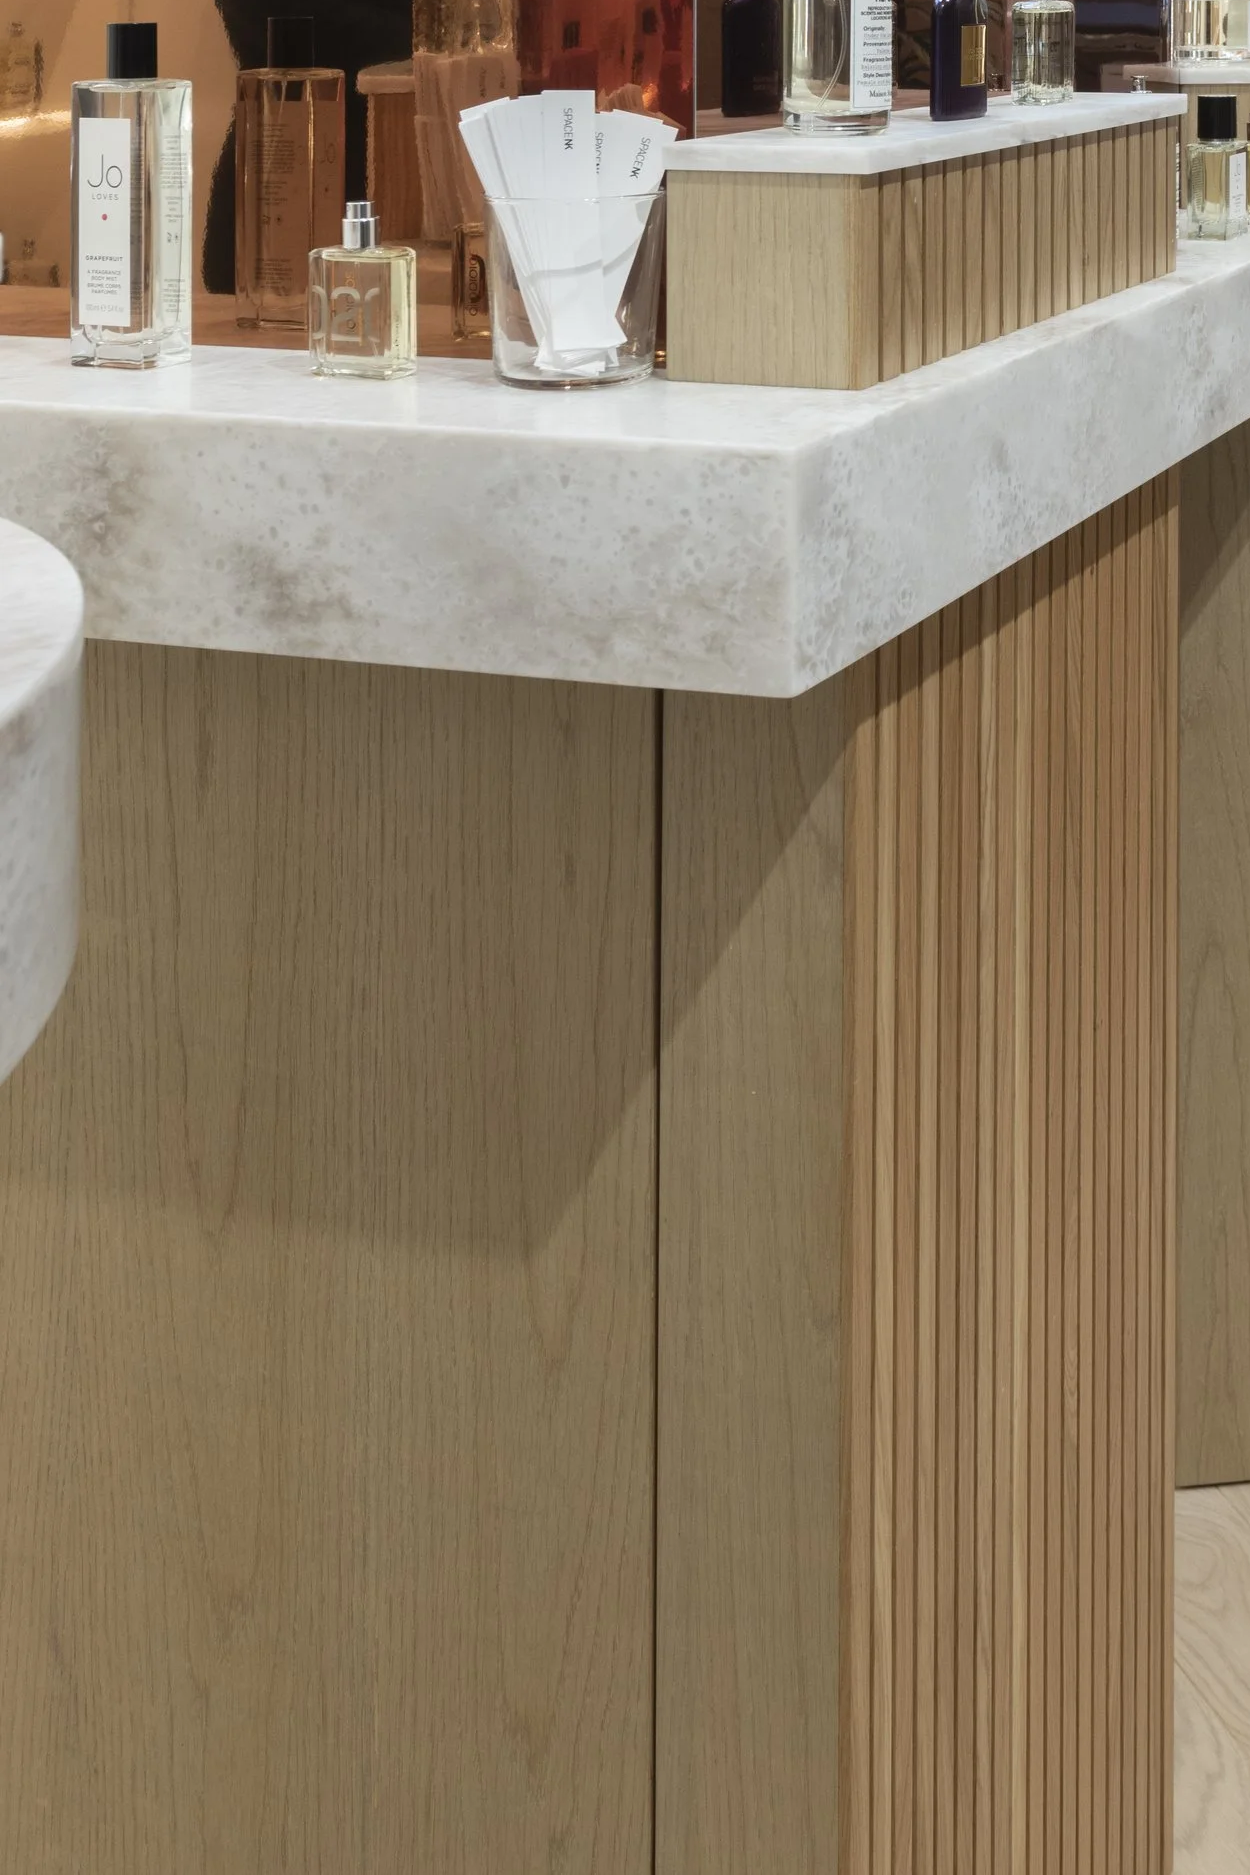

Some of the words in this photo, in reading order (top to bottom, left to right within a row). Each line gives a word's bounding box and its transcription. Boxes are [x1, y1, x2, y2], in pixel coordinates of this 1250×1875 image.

[86, 153, 123, 188] Jo
[91, 193, 120, 201] LOVES
[85, 254, 124, 262] GRAPEFRUIT
